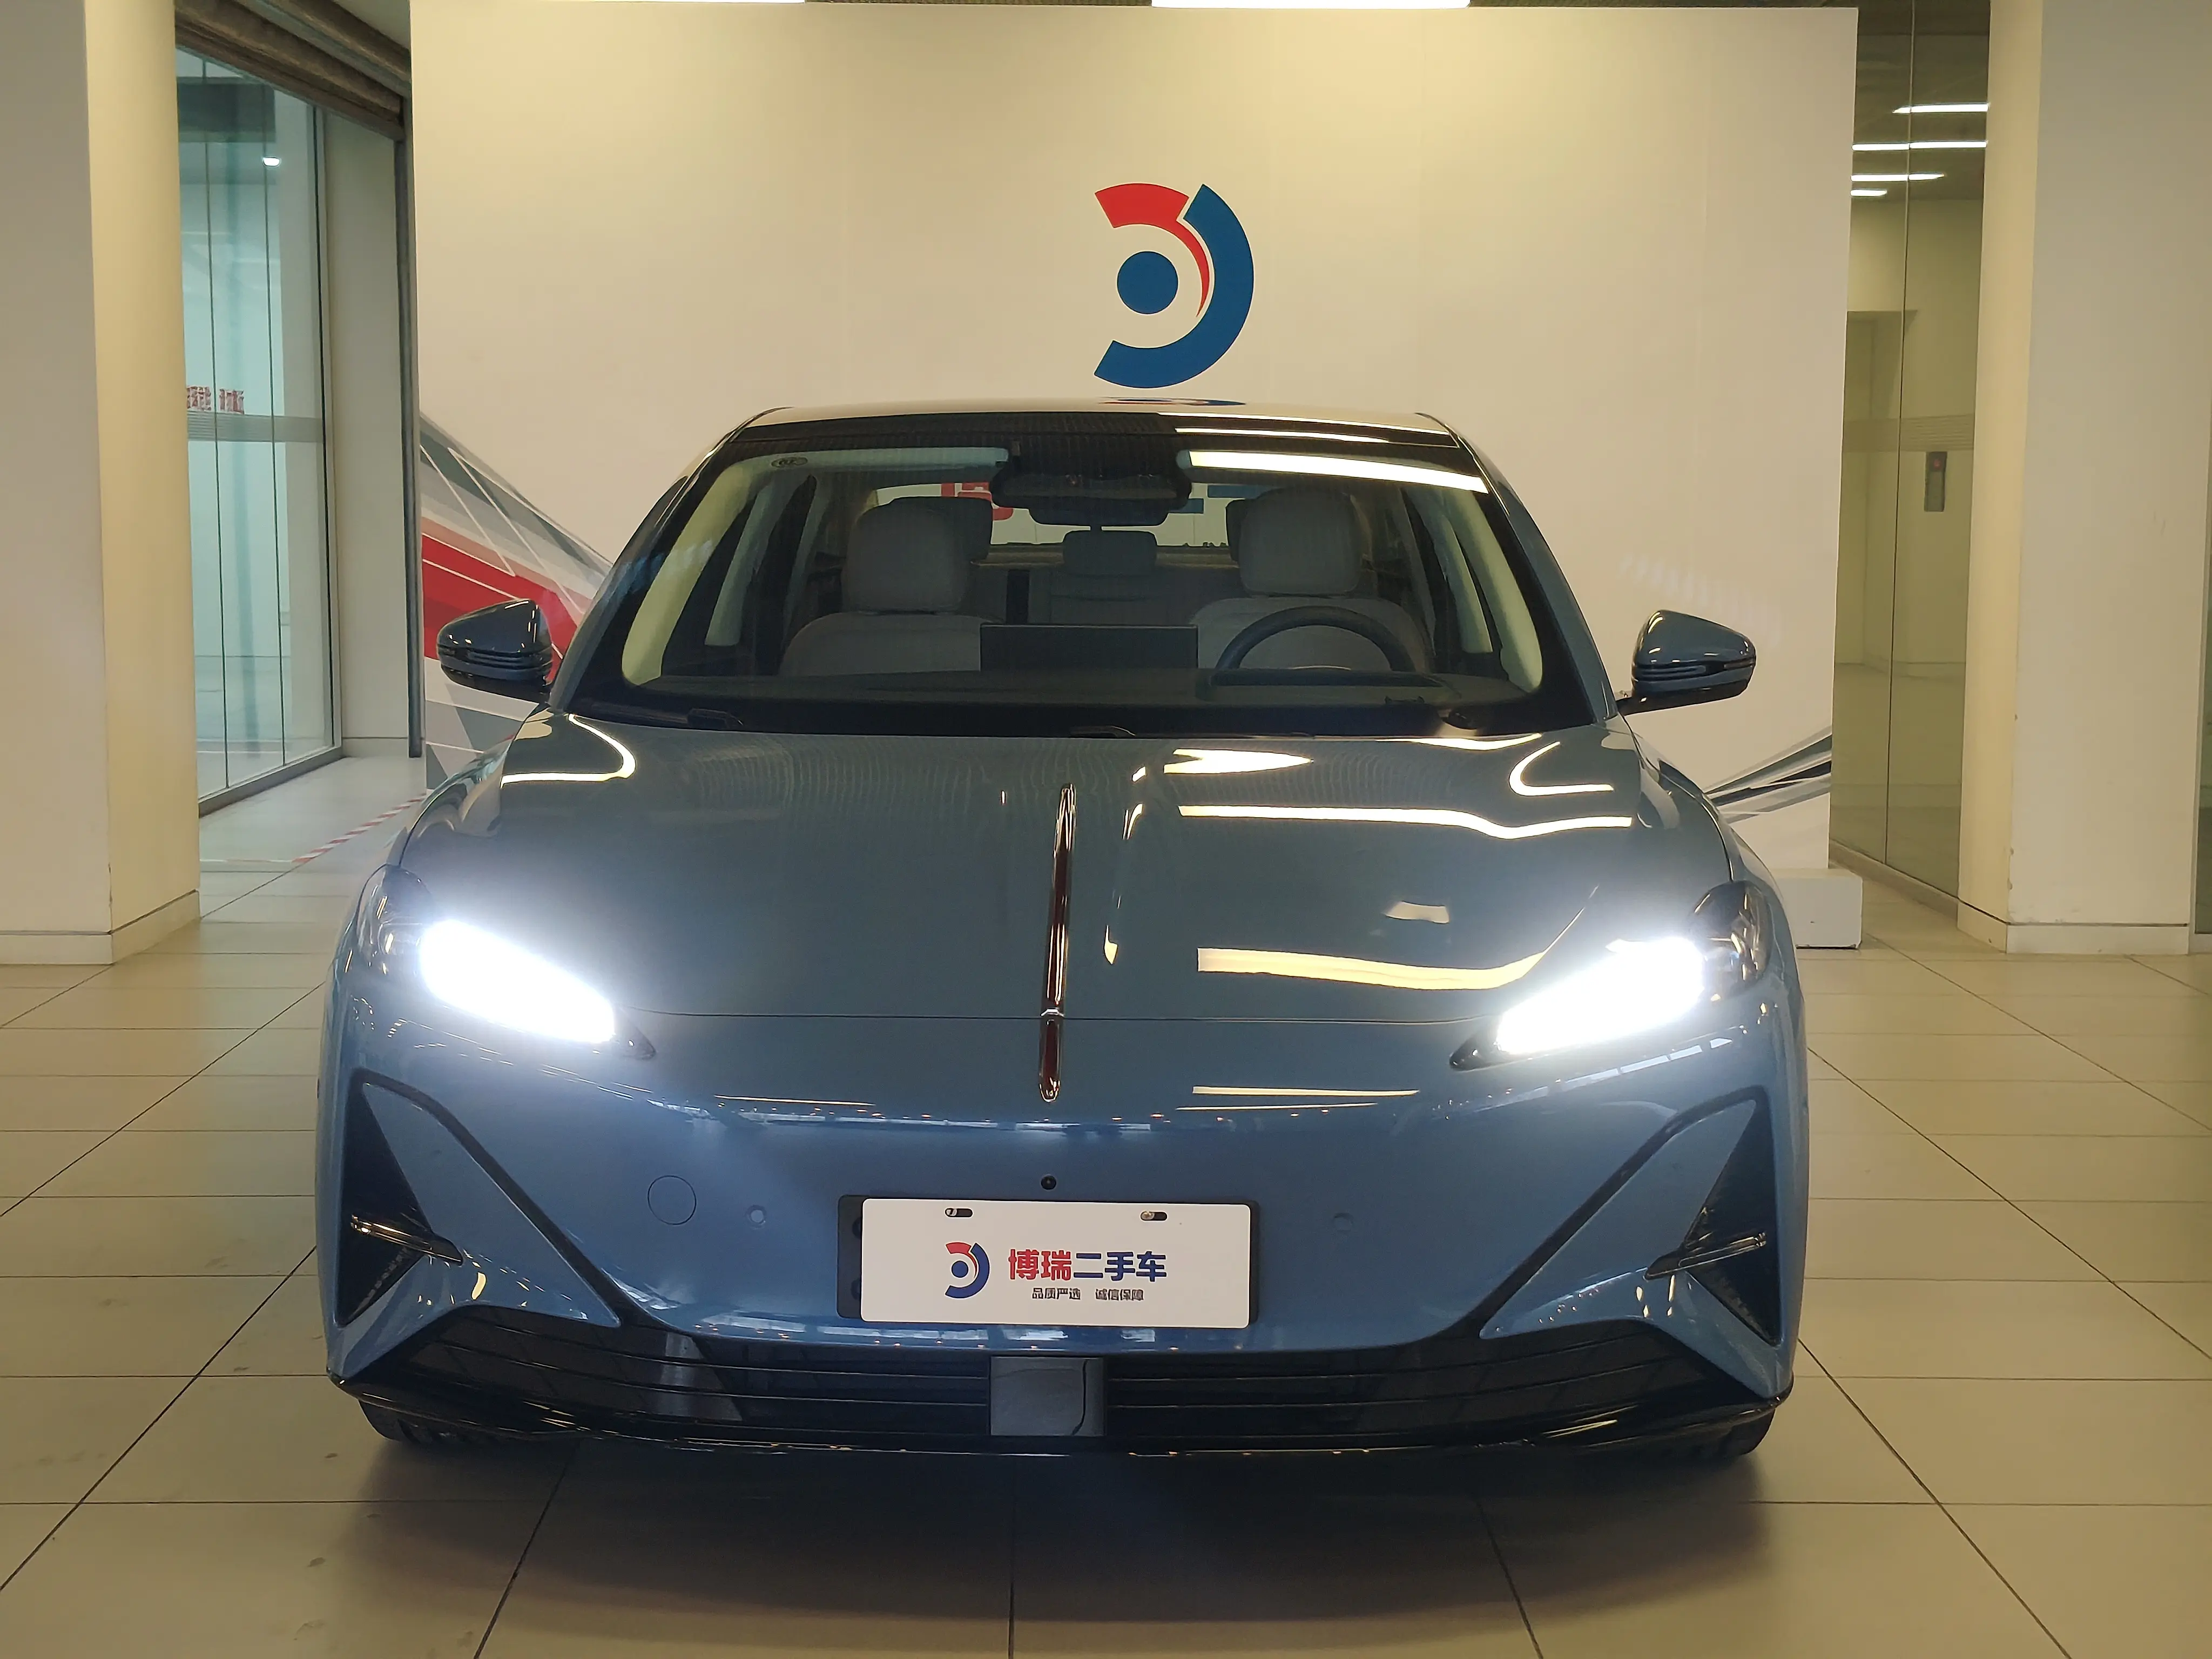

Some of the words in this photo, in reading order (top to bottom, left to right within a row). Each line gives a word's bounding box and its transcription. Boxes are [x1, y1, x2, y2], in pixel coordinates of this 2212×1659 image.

[1008, 1249, 1167, 1282] 博瑞二手车
[1032, 1287, 1081, 1300] 品质严选
[1095, 1288, 1144, 1301] 诚信保障
